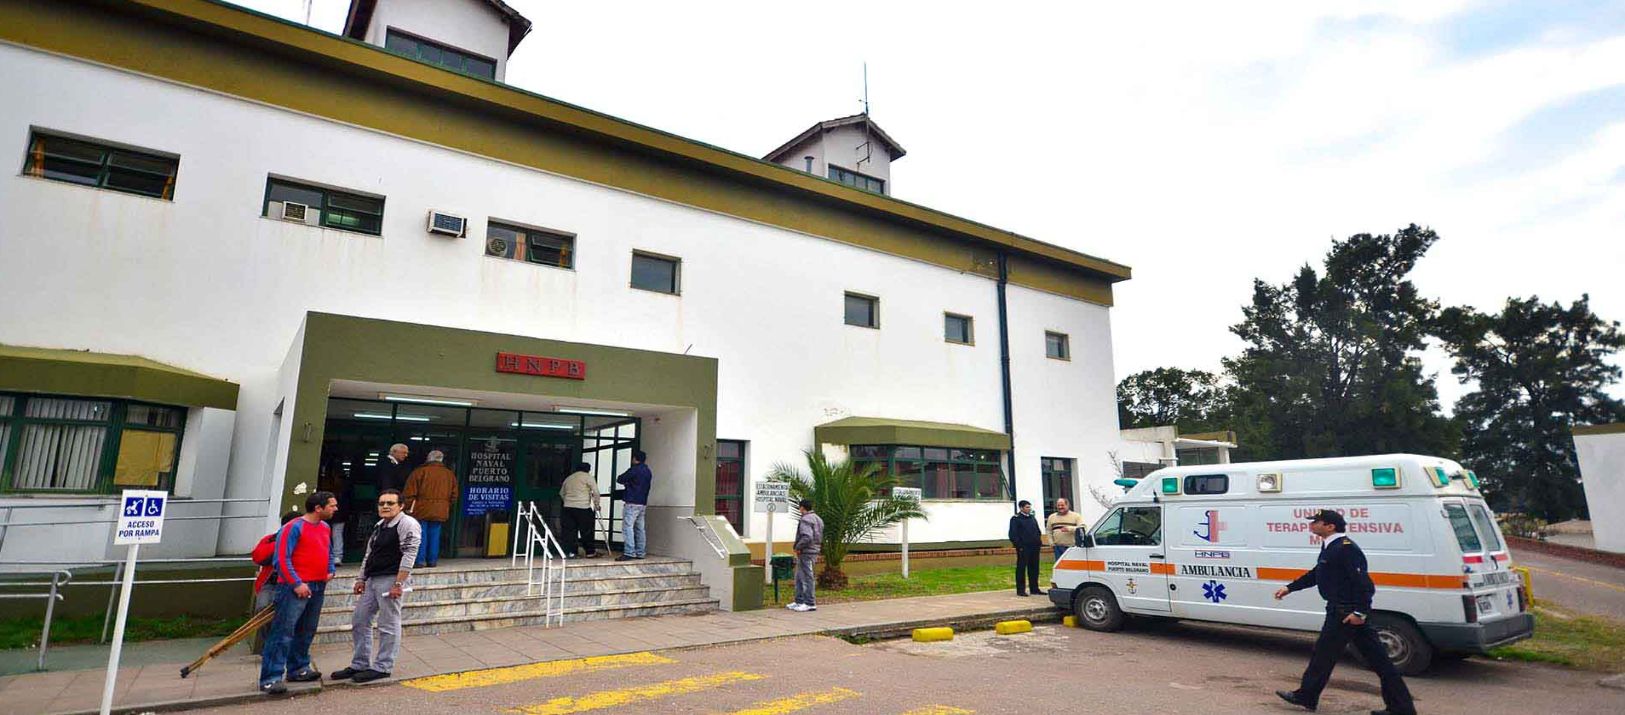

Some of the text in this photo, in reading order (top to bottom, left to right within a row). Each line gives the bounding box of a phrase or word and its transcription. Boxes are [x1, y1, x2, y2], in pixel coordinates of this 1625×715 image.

[471, 452, 511, 460] HOSPITAL
[476, 460, 505, 468] NAVAL
[472, 467, 508, 475] PUERTO
[469, 474, 510, 482] BELGRANO
[1350, 508, 1369, 518] DE
[135, 529, 159, 537] RAMPA
[1182, 564, 1251, 577] AMBULANCIA
